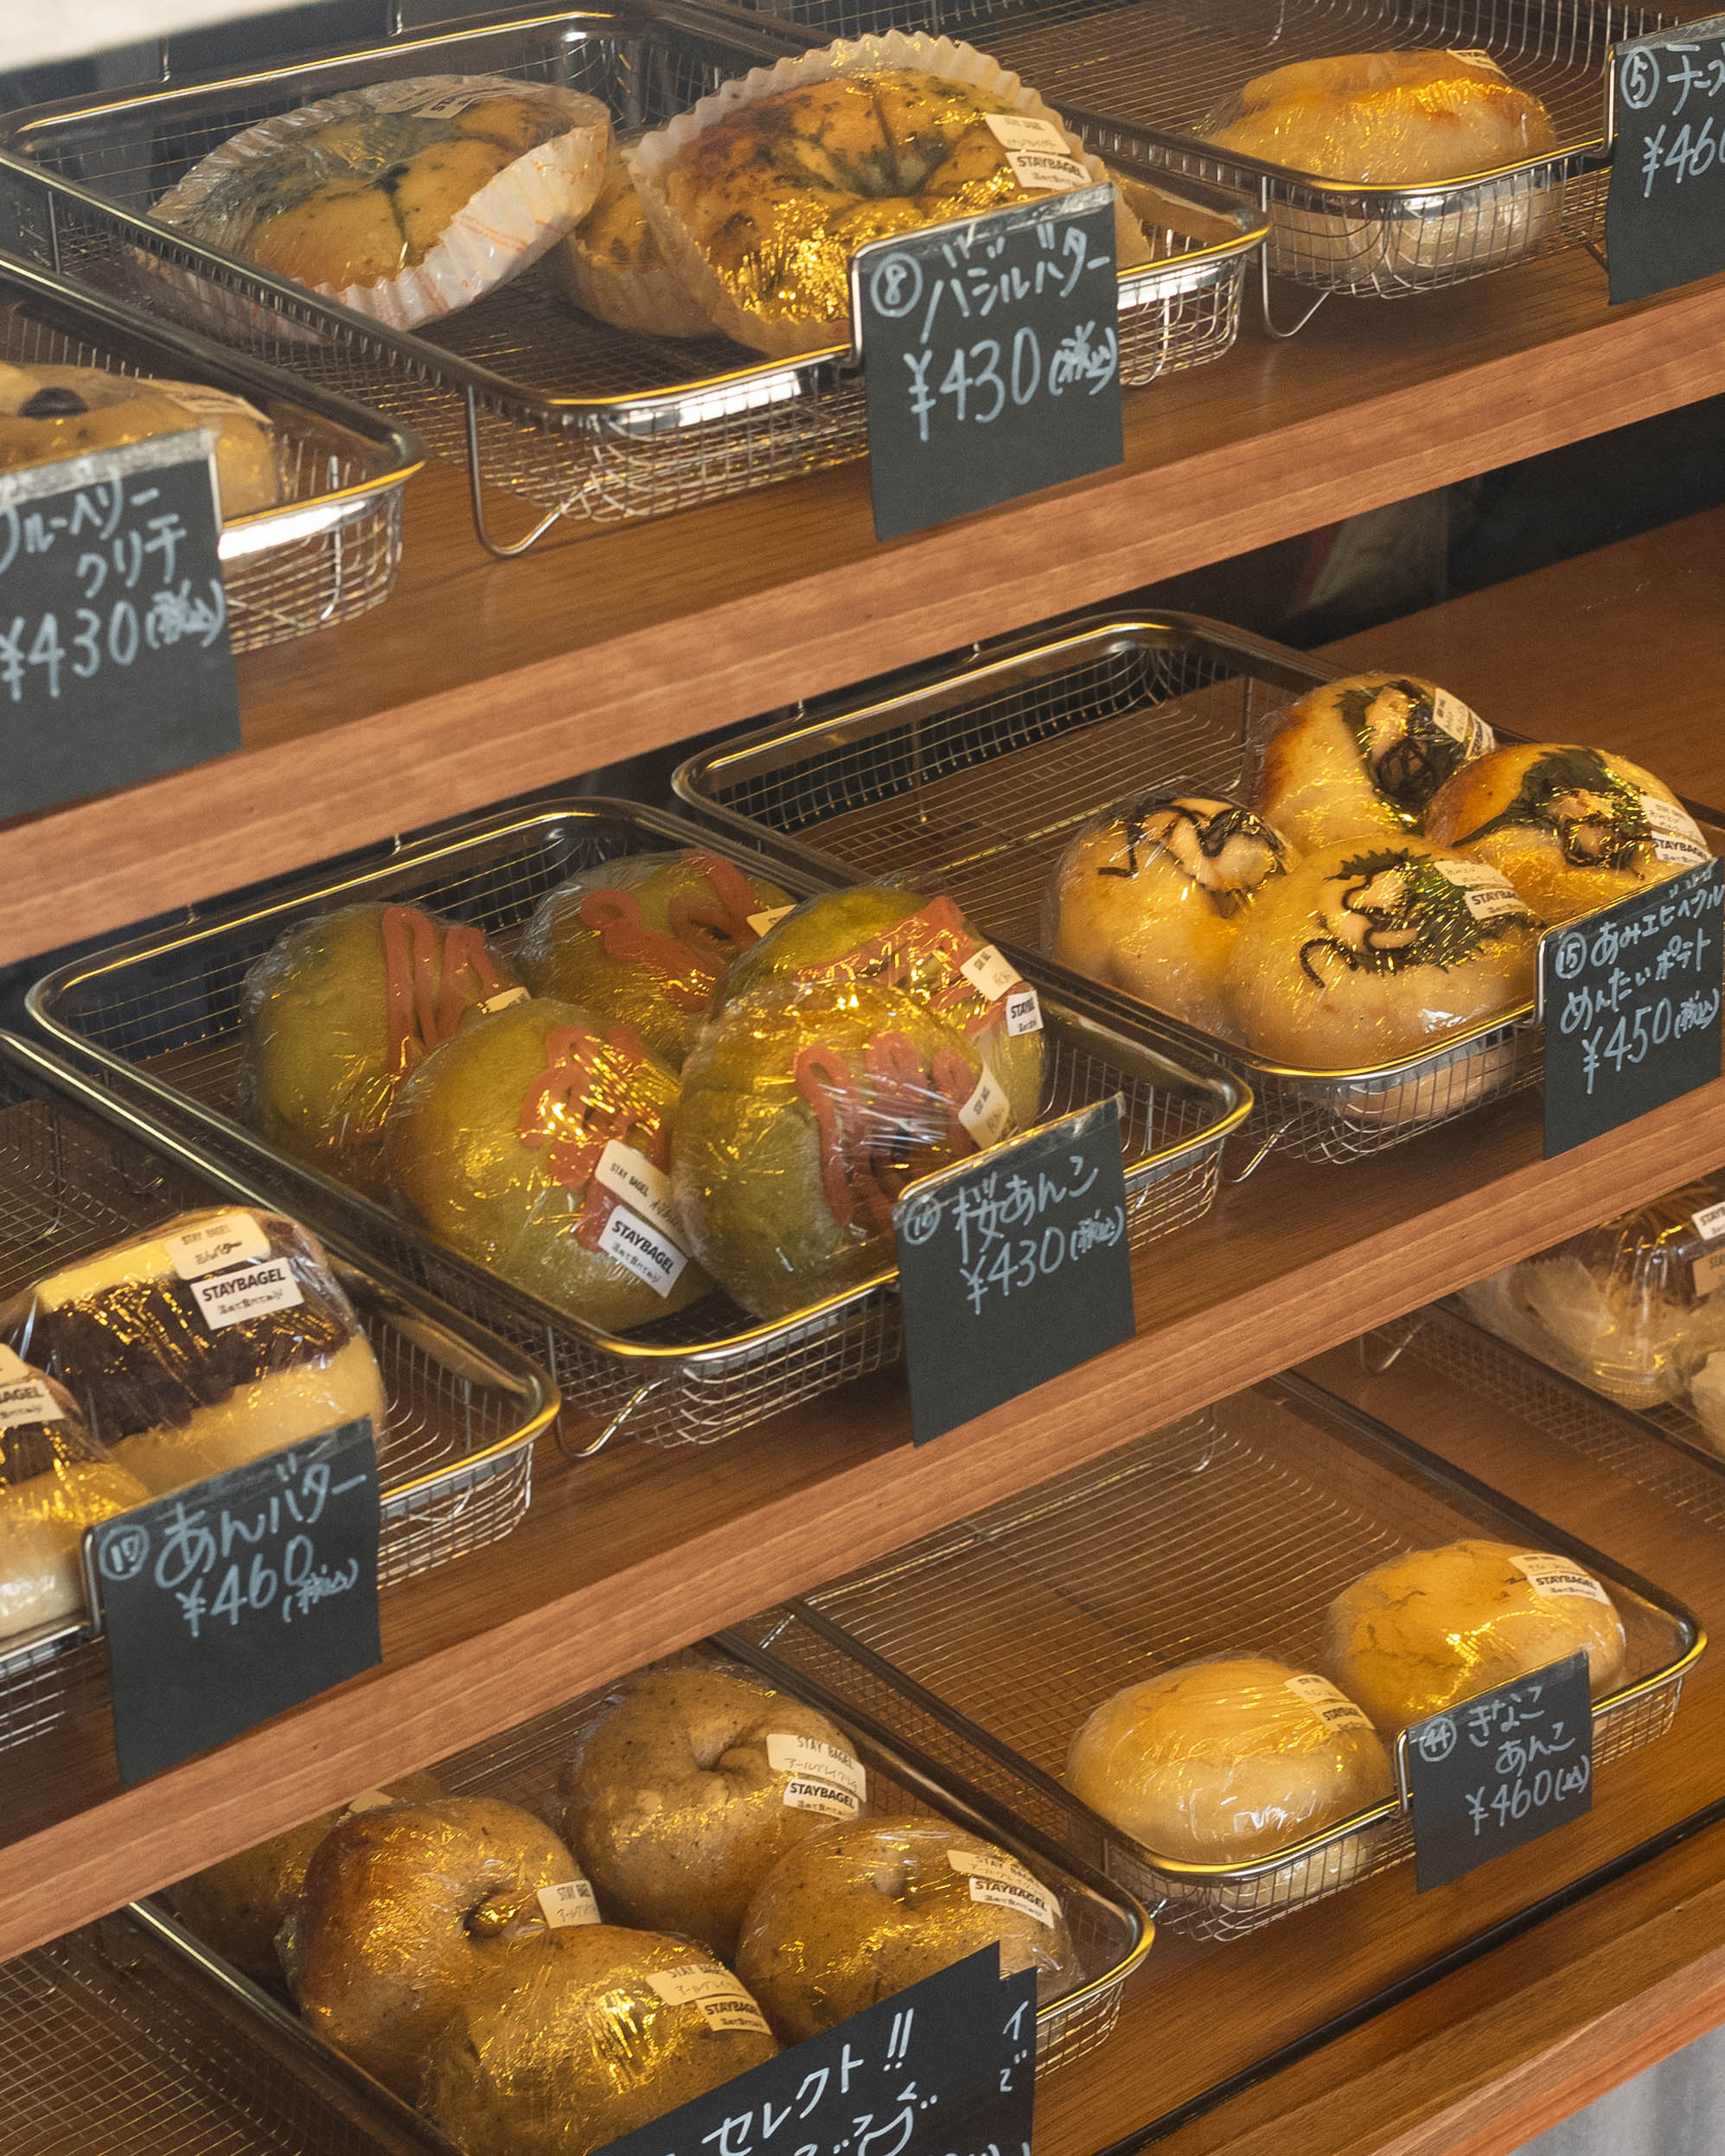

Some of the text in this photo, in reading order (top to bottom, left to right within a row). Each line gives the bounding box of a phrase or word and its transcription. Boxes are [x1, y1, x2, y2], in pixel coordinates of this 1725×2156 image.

[1642, 117, 1725, 198] ¥46
[611, 1220, 675, 1276] STAYBAGEL
[201, 1267, 286, 1302] STAYBAGEL
[796, 1735, 823, 1753] STAY
[1495, 1721, 1576, 1777] あんこ
[789, 1782, 855, 1810] STAYBAGEL
[974, 1880, 1047, 1912] STAYBAGEL
